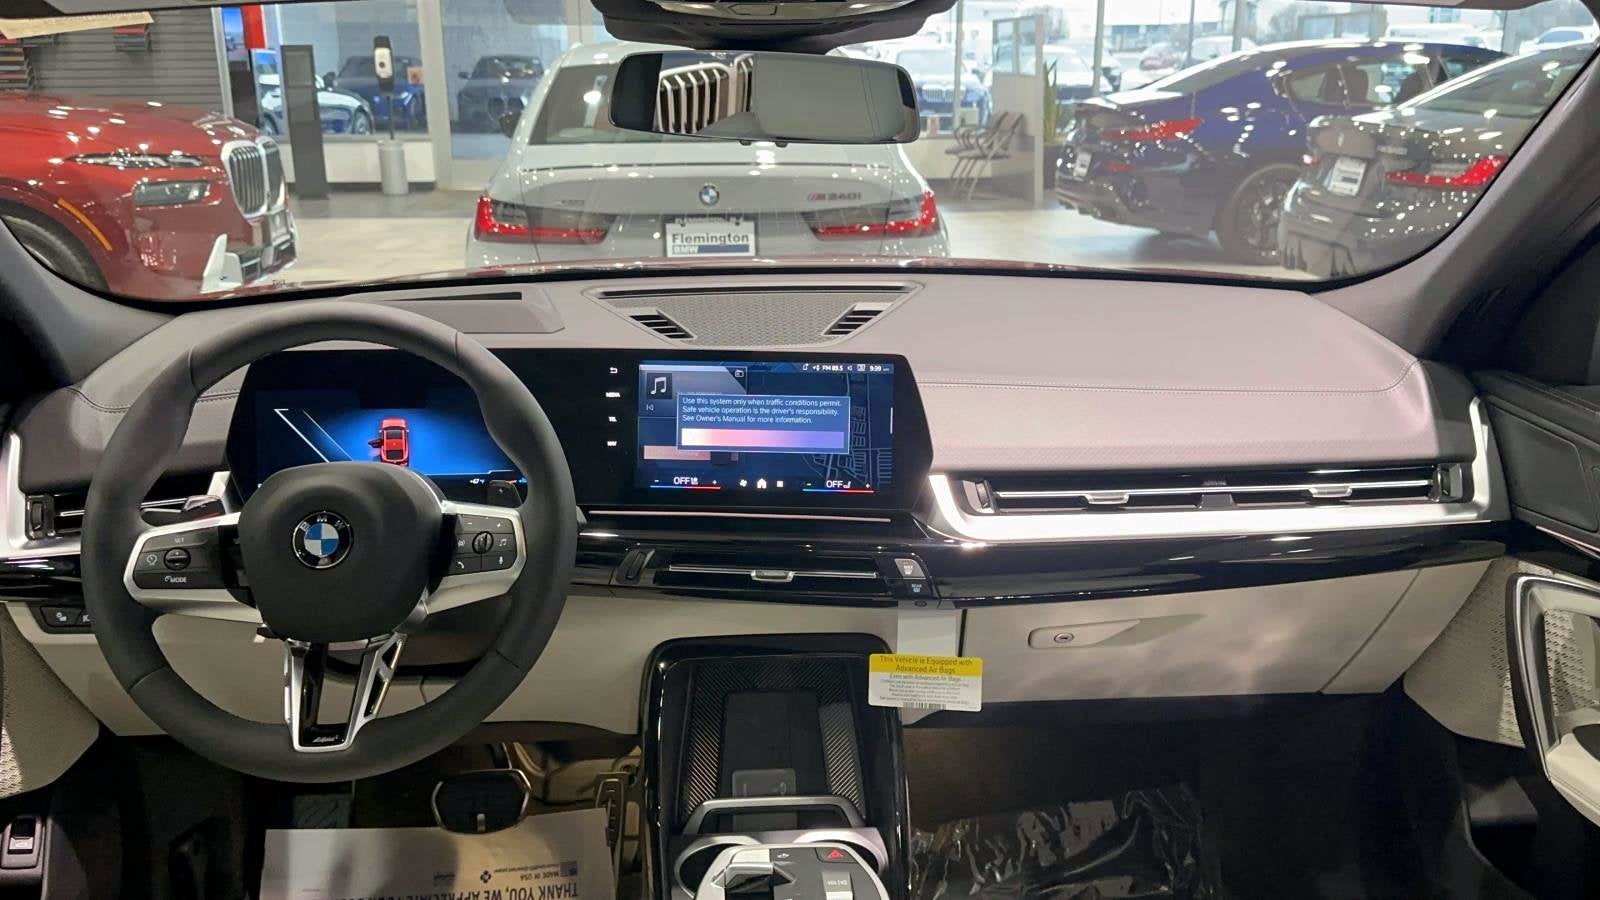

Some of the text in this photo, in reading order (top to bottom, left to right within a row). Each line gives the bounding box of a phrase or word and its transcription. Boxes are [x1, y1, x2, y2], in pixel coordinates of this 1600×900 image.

[672, 233, 749, 245] Flemington
[673, 246, 698, 255] BMW
[673, 476, 691, 486] OFF
[826, 480, 843, 489] OFF
[894, 655, 919, 663] Vehicle
[926, 657, 958, 666] Equipped
[895, 664, 927, 673] Advanced
[940, 667, 956, 675] Bags
[484, 889, 502, 900] WE
[539, 882, 578, 900] THANK
